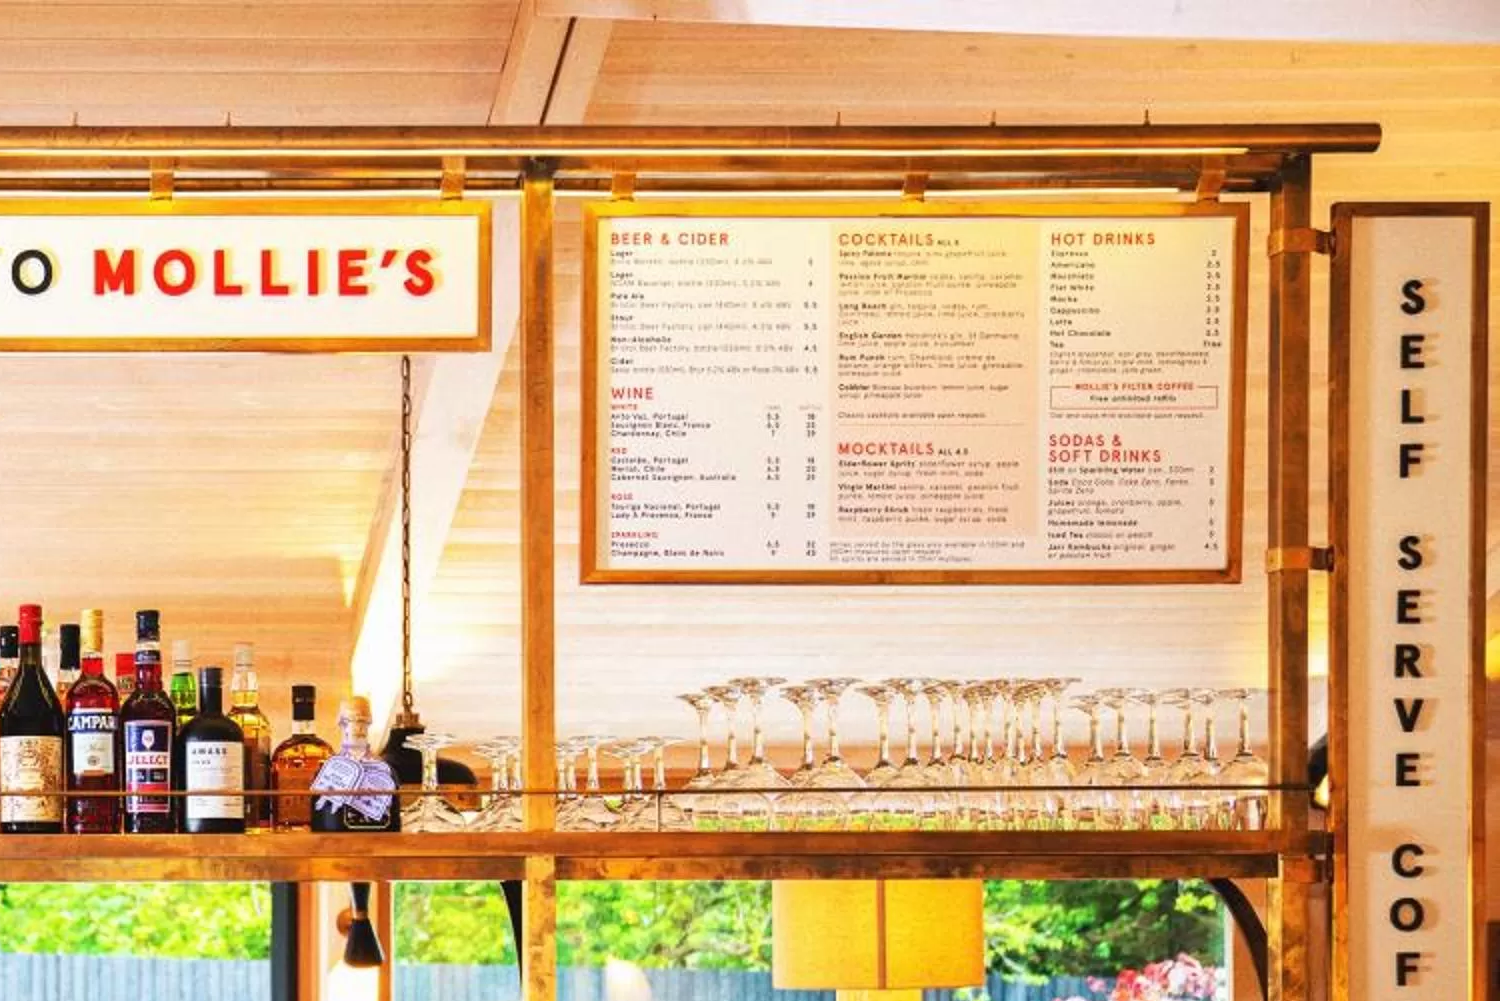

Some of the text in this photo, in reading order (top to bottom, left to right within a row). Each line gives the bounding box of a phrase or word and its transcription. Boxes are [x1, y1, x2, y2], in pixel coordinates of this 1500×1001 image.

[610, 232, 729, 245] BEER & CIDER
[838, 233, 934, 247] COCKTAILS
[1051, 233, 1155, 246] HOT DRINKS
[1400, 279, 1426, 479] SELF
[611, 387, 654, 400] WINE
[1049, 434, 1122, 447] SODAS &
[837, 443, 934, 456] MOCKTAILS
[1048, 450, 1161, 463] SOFT DRINKS
[1393, 535, 1424, 787] SERVE
[67, 715, 119, 730] CAMPAR
